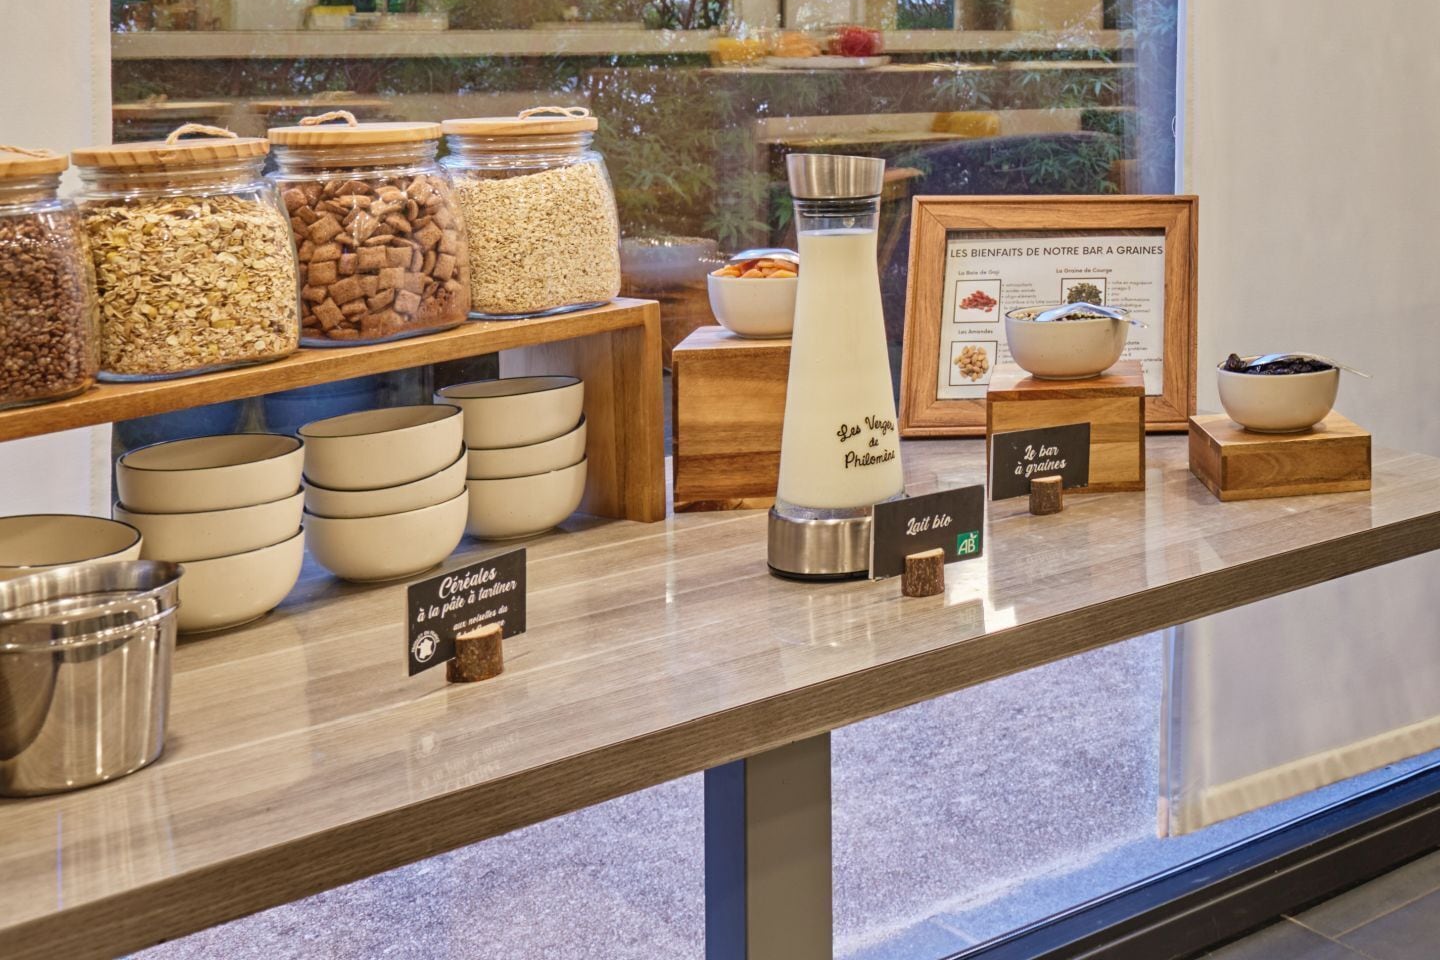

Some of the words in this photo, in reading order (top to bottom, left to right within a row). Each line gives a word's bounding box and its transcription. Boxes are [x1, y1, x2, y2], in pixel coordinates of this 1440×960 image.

[950, 248, 968, 258] LES
[971, 247, 1023, 257] BIENFAITS
[1026, 247, 1040, 256] DE
[1043, 246, 1079, 256] NOTRE
[1082, 246, 1103, 255] BAR
[1106, 246, 1113, 254] A
[1116, 245, 1163, 255] GRAINES
[837, 424, 861, 442] Les
[869, 437, 879, 447] de
[1024, 444, 1037, 460] Le
[1039, 444, 1059, 457] bar
[1014, 461, 1023, 475] à
[1025, 459, 1067, 478] graines
[906, 516, 931, 535] Lait
[932, 514, 952, 529] bio
[957, 538, 976, 555] AB
[438, 567, 498, 599] Céréales
[417, 608, 425, 622] à
[428, 605, 440, 619] la
[441, 596, 465, 619] pâte
[467, 589, 476, 604] à
[478, 580, 517, 601] tartiner
[468, 609, 497, 625] noisettes
